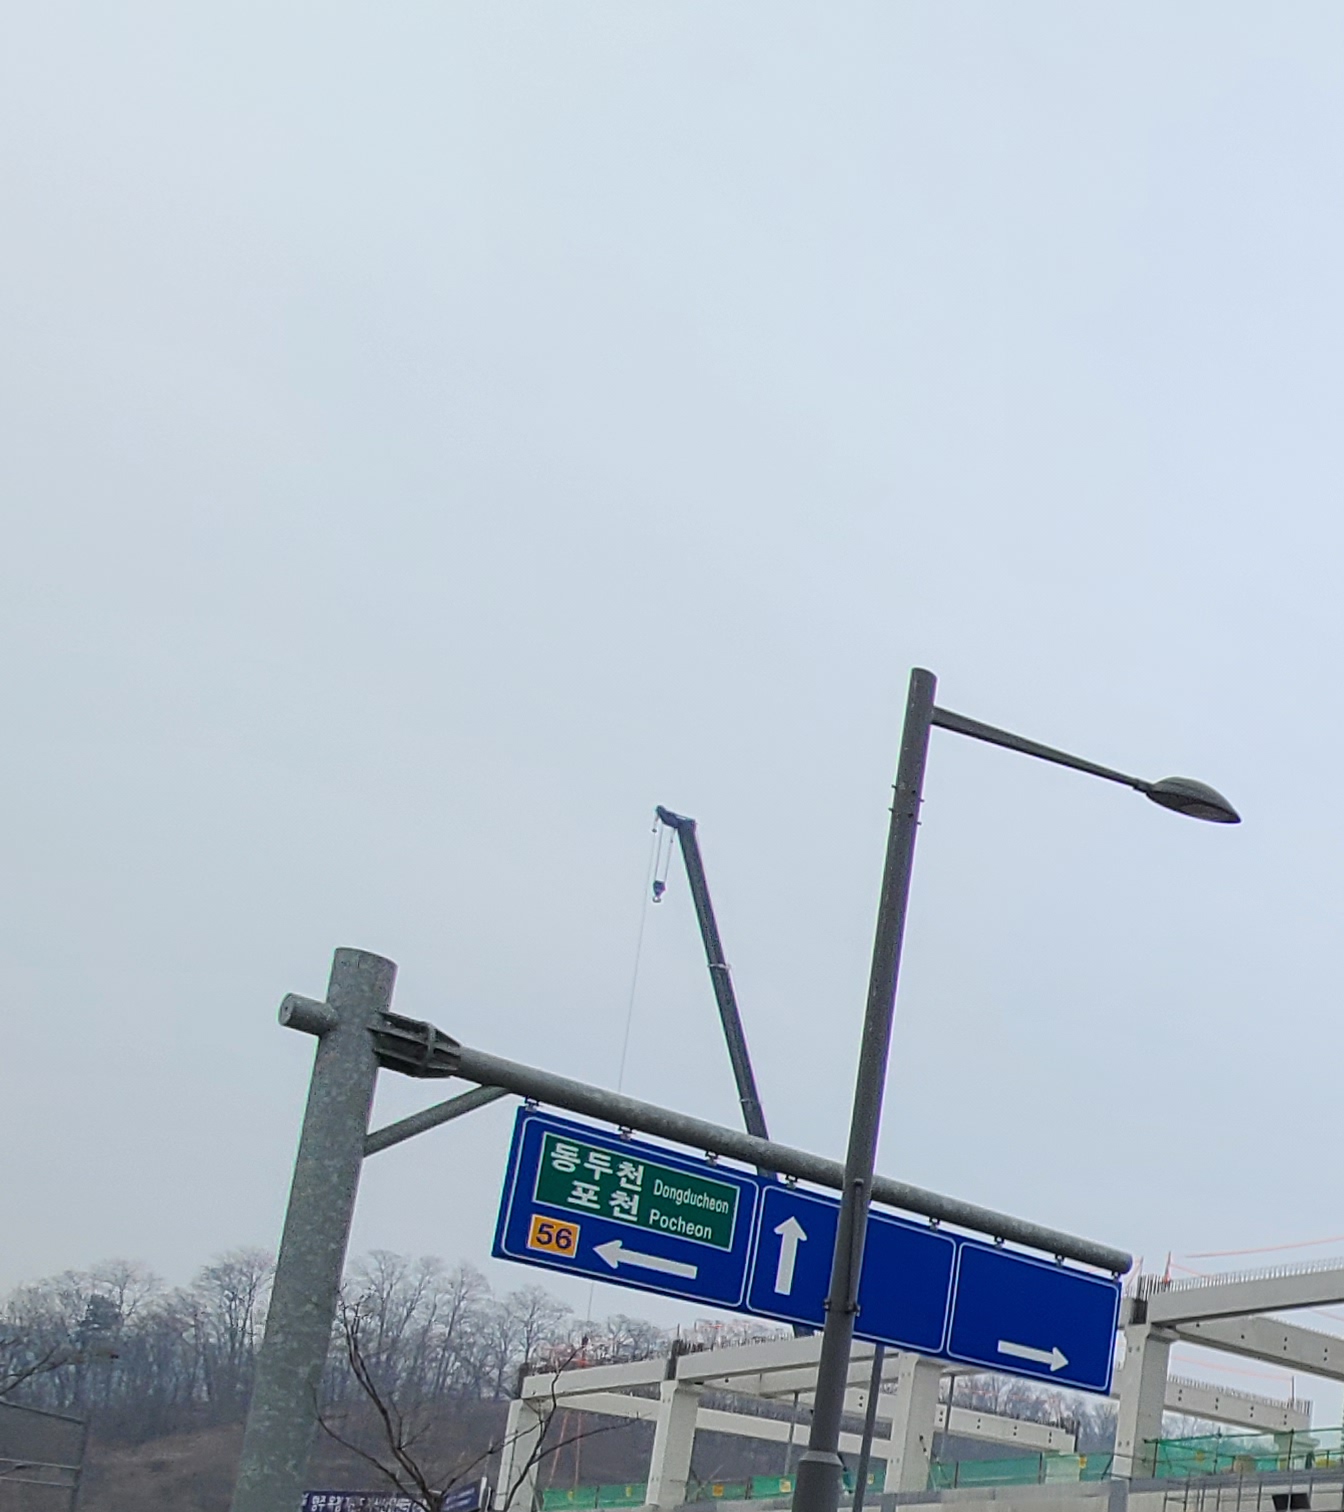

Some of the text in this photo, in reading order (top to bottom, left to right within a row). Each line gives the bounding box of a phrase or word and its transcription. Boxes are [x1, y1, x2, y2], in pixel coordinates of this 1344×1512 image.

[550, 1142, 645, 1191] 동두천
[567, 1179, 640, 1222] 포천
[653, 1178, 729, 1214] Dongducheon
[536, 1223, 573, 1250] 56
[649, 1208, 713, 1240] Pocheon
